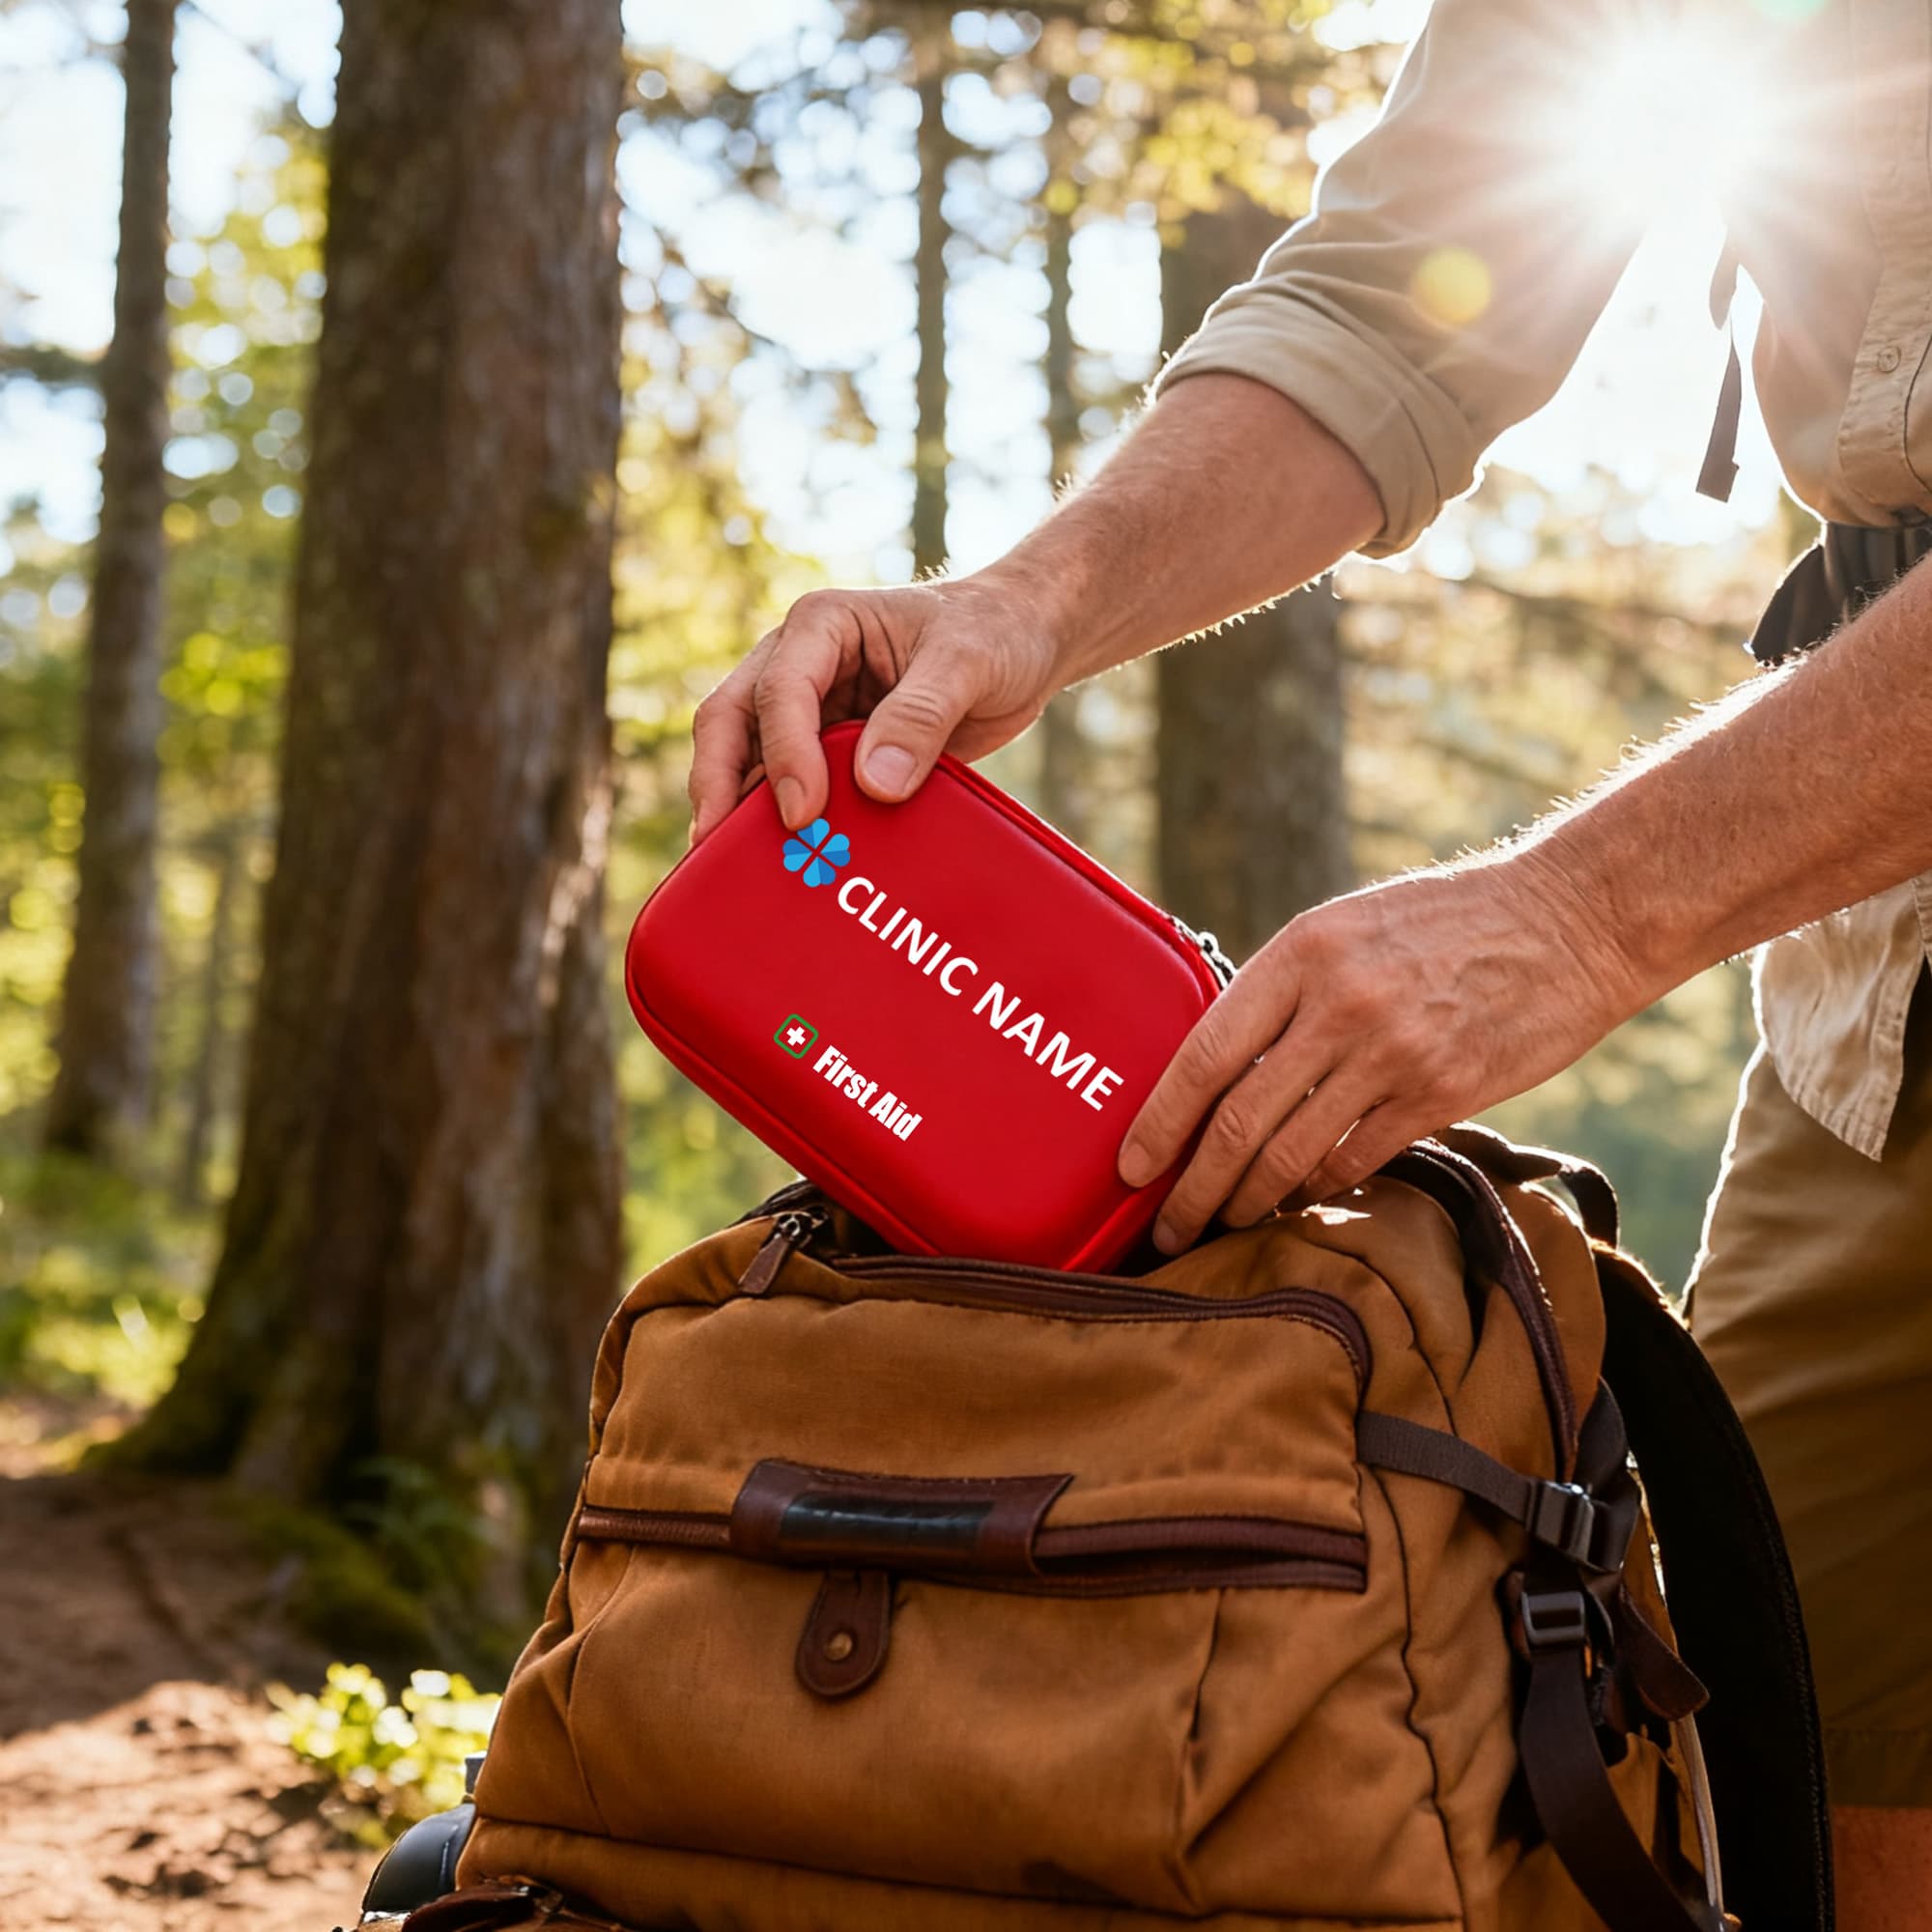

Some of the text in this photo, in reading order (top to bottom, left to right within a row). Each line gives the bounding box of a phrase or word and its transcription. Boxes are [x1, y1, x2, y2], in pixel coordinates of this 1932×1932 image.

[838, 876, 1124, 1111] CLINIC NAME
[812, 1044, 923, 1142] First Aid
